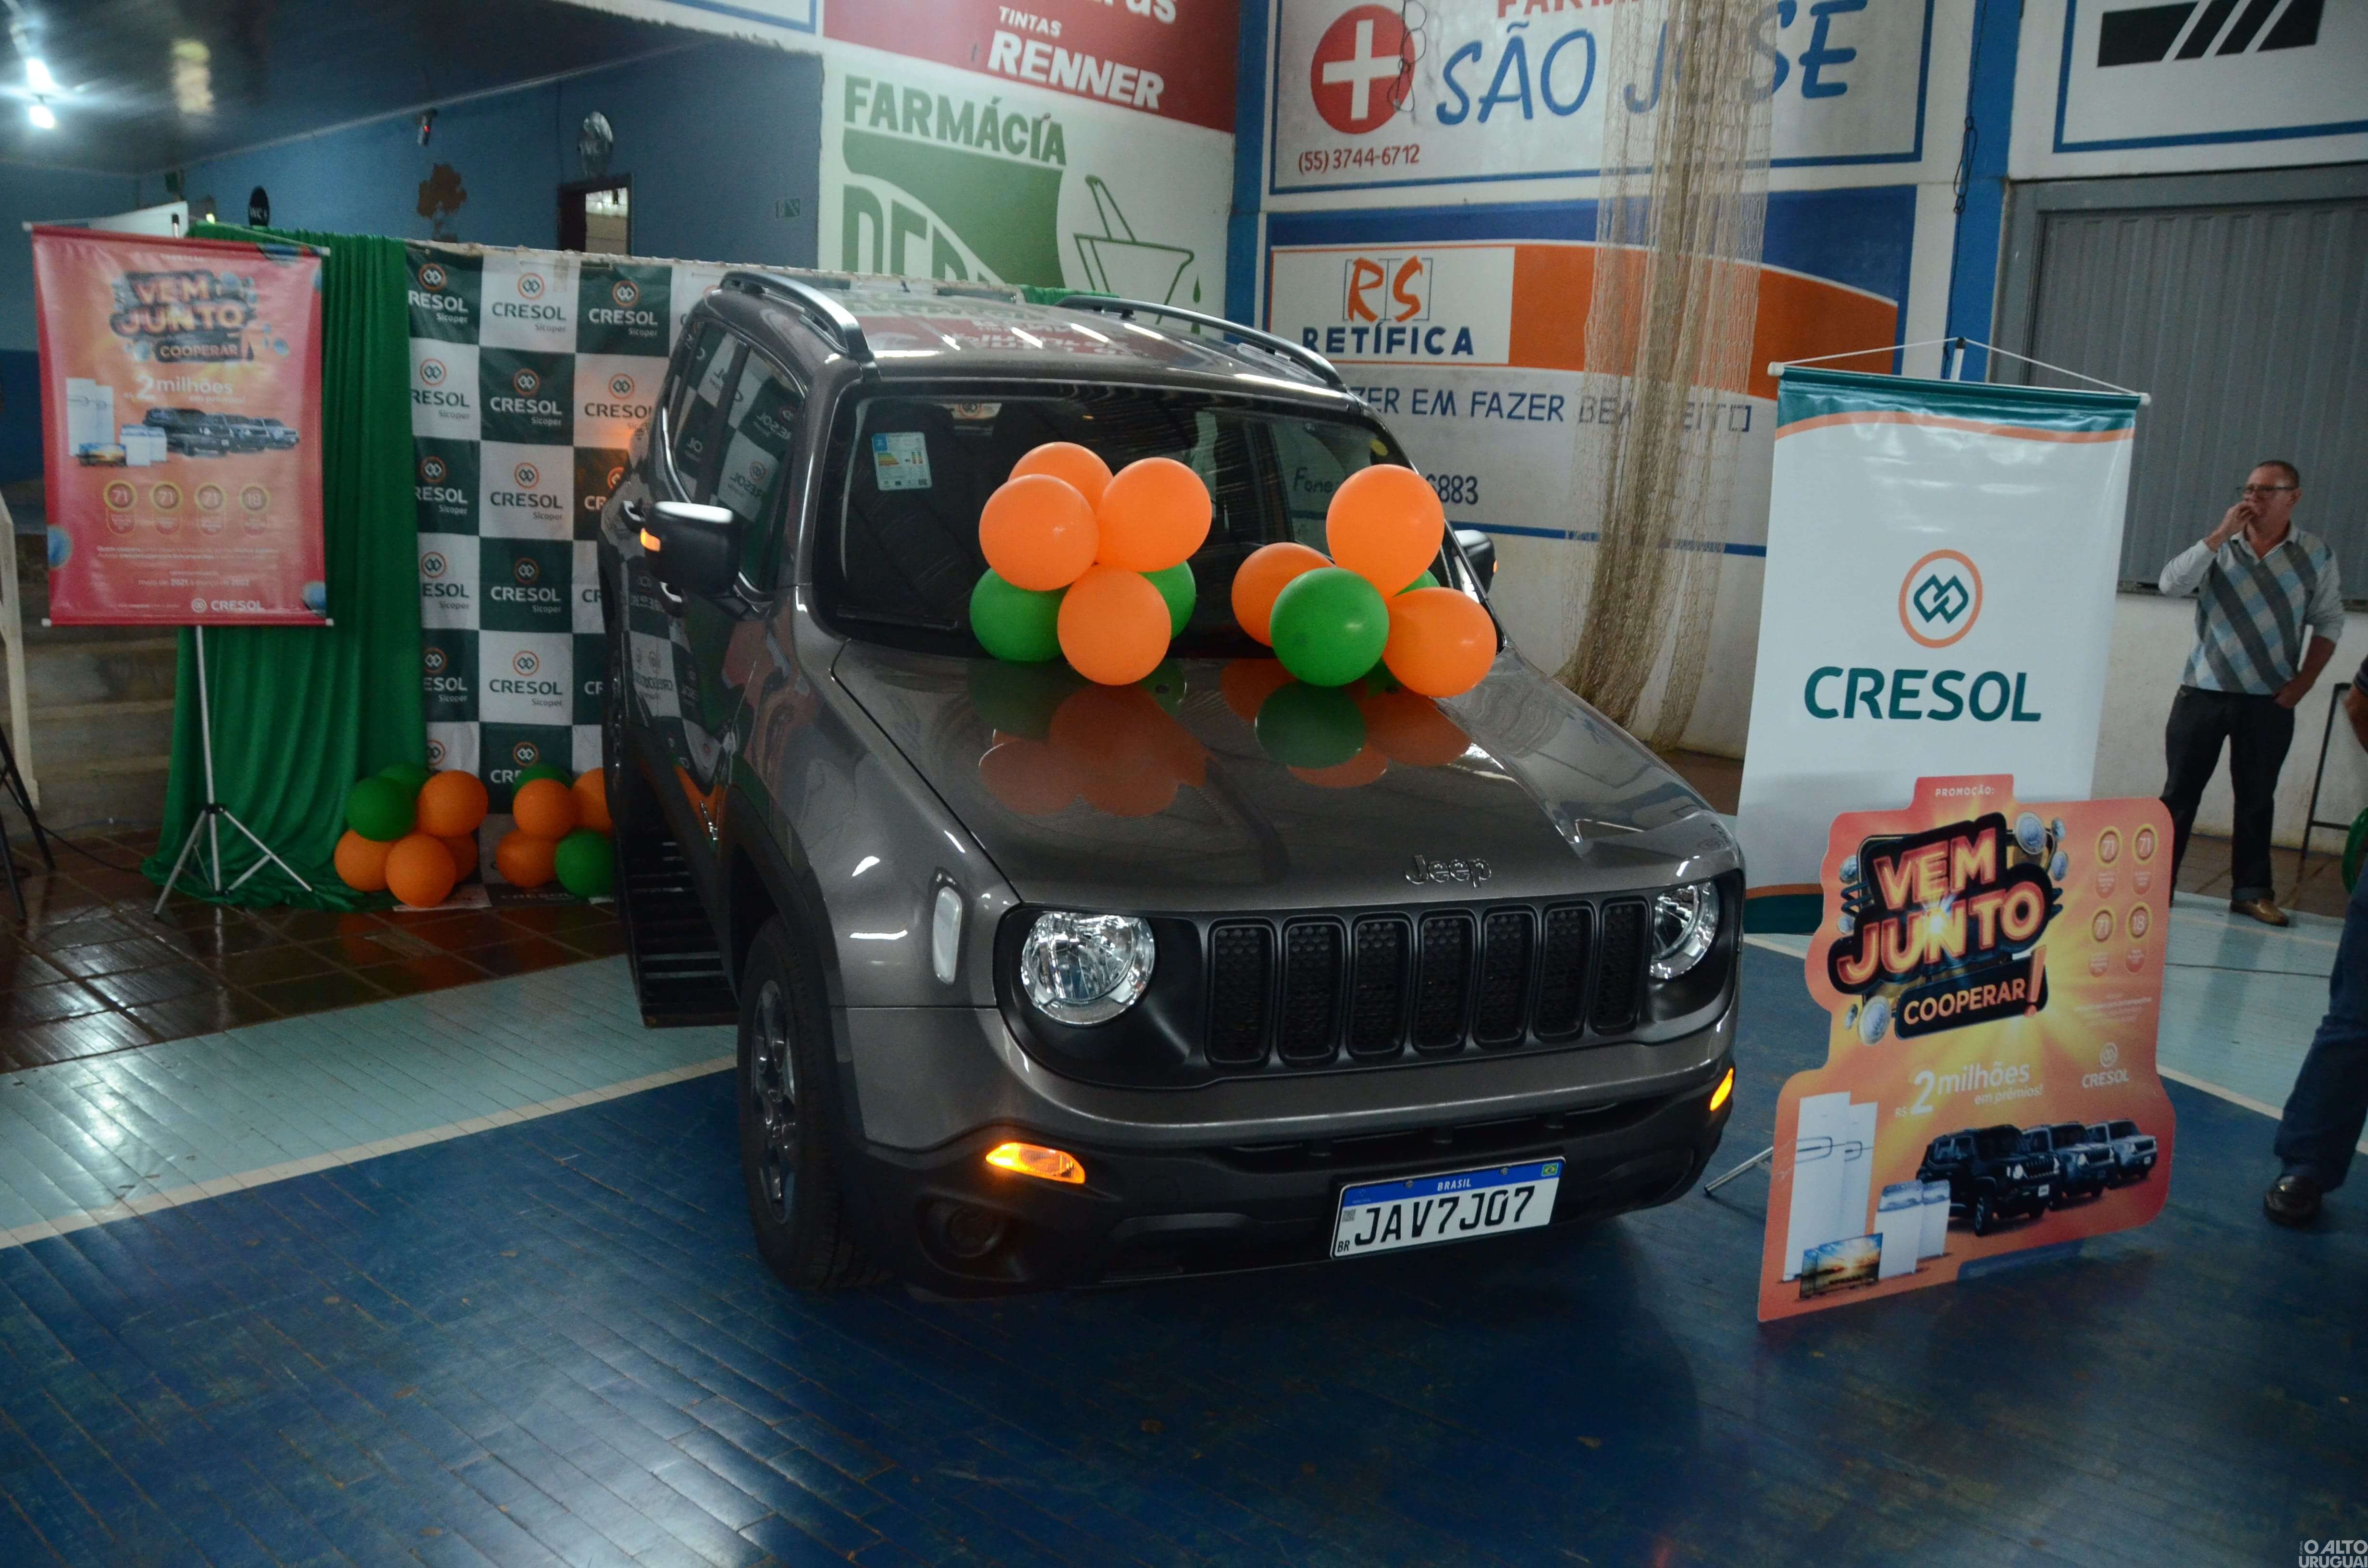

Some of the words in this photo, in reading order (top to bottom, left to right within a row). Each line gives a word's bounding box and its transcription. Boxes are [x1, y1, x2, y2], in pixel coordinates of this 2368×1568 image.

[999, 7, 1062, 37] TINTAS
[988, 30, 1164, 109] RENNER
[1436, 22, 1596, 125] SÃO
[1299, 150, 1329, 175] (55)
[1333, 144, 1420, 169] 3744-6712
[134, 275, 210, 305] VEM
[408, 291, 469, 312] RESOL
[119, 301, 245, 334] JUNTO
[437, 312, 469, 324] Sicoper
[493, 302, 566, 321] CRESOL
[589, 308, 658, 325] CRESOL
[535, 322, 566, 333] Sicoper
[629, 327, 658, 338] Sicoper
[1303, 321, 1473, 355] RETÍFICA
[136, 373, 155, 400] 2
[412, 389, 470, 407] RESOL
[490, 397, 562, 416] CRESOL
[1412, 389, 1456, 416] EM
[1470, 391, 1565, 422] FAZER
[439, 409, 470, 420] Sicoper
[531, 416, 562, 428] Sicoper
[415, 486, 468, 504] RESOL
[490, 491, 563, 510] CRESOL
[439, 504, 468, 516] Sicoper
[532, 511, 563, 522] Sicoper
[422, 583, 470, 599] ESOL
[490, 586, 561, 603] CRESOL
[211, 600, 264, 612] CRESOL
[439, 600, 469, 611] Sicoper
[532, 604, 561, 614] Sicoper
[424, 677, 468, 692] ESOL
[489, 679, 563, 696] CRESOL
[438, 694, 468, 704] Sicoper
[531, 698, 563, 708] Sicoper
[1804, 666, 2042, 722] CRESOL
[2138, 837, 2150, 853] 71
[1405, 854, 1492, 888] Jeep
[1874, 827, 1997, 910] VEM
[1836, 881, 2046, 985] JUNTO
[1910, 1070, 1935, 1115] 2
[1937, 1060, 2031, 1096] milhões
[2082, 1068, 2130, 1089] CRESOL
[1437, 1178, 1472, 1191] BRASIL
[1354, 1185, 1535, 1246] JAV7J07
[1337, 1239, 1350, 1252] BR
